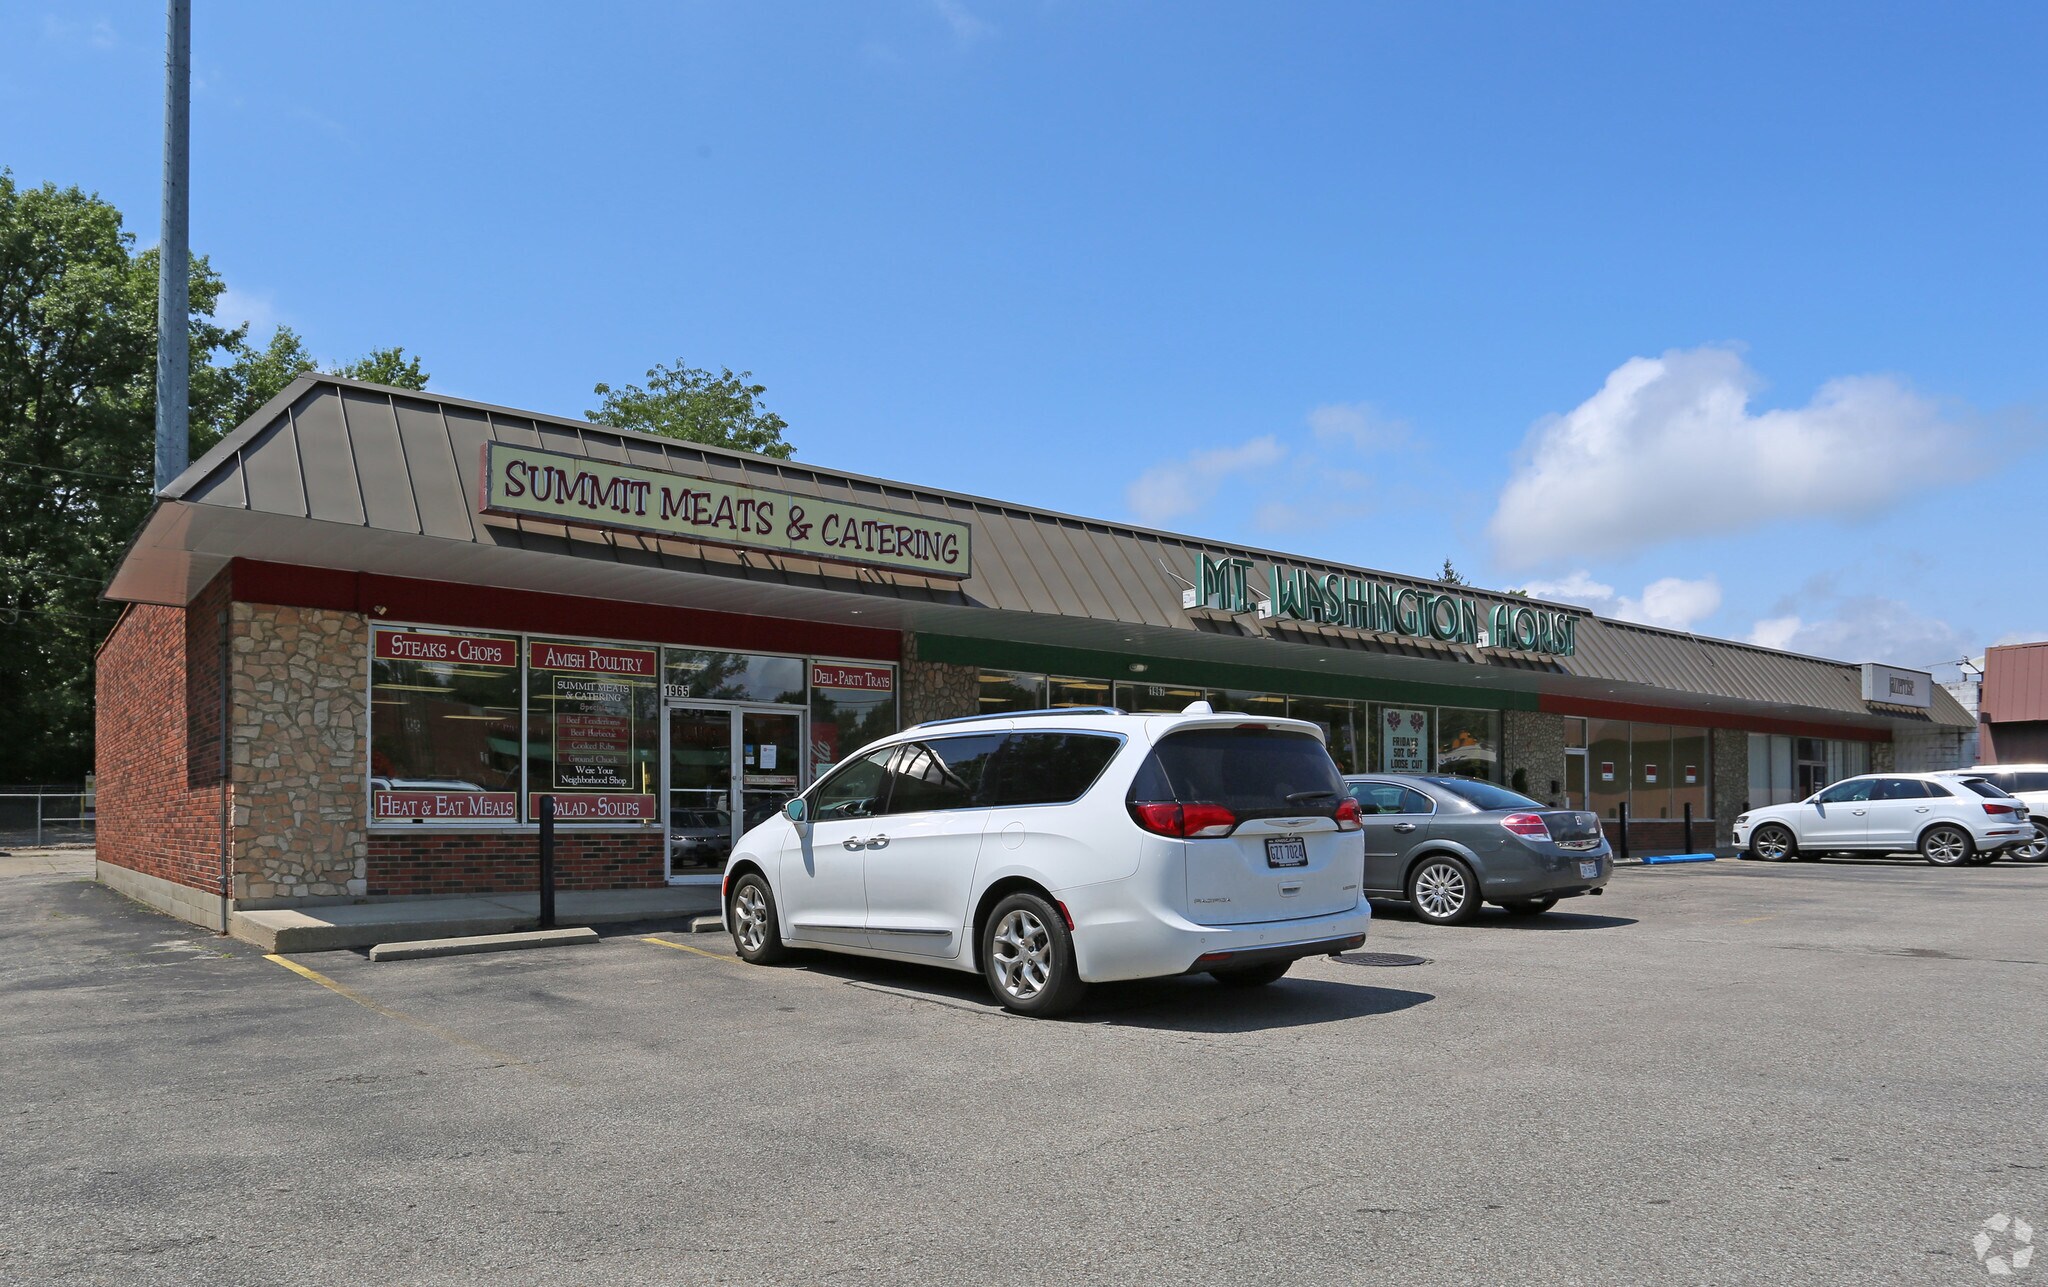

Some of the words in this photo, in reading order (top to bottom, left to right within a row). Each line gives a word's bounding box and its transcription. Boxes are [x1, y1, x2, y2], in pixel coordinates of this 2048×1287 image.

[504, 459, 652, 517] SUMMIT
[660, 487, 774, 536] MEATS
[786, 506, 812, 541] &
[821, 513, 960, 564] CATERING
[1195, 552, 1257, 613] MT.
[1268, 564, 1479, 644] WASHINGTON
[1488, 604, 1580, 657] FLORIST
[391, 634, 447, 658] STEAKS
[457, 640, 502, 662] CHOPS
[544, 647, 586, 668] AMISH
[589, 650, 643, 672] POULTRY
[814, 668, 833, 684] DELI
[838, 670, 864, 686] PARTY
[865, 672, 890, 688] TRAYS
[557, 681, 596, 692] SUMMIT
[597, 683, 630, 693] MEATS
[665, 684, 689, 698] 1965
[565, 691, 573, 700] &
[574, 691, 621, 702] CATERING
[568, 754, 594, 763] Ground
[1390, 758, 1409, 769] LOOSE
[1411, 759, 1424, 769] CUT
[597, 766, 614, 775] Your
[561, 774, 608, 786] Neighborhood
[608, 776, 627, 787] Shop
[378, 795, 418, 816] HEAT
[421, 800, 432, 815] &
[435, 795, 464, 816] EAT
[468, 796, 514, 816] MEALS
[597, 797, 640, 816] SOUPS
